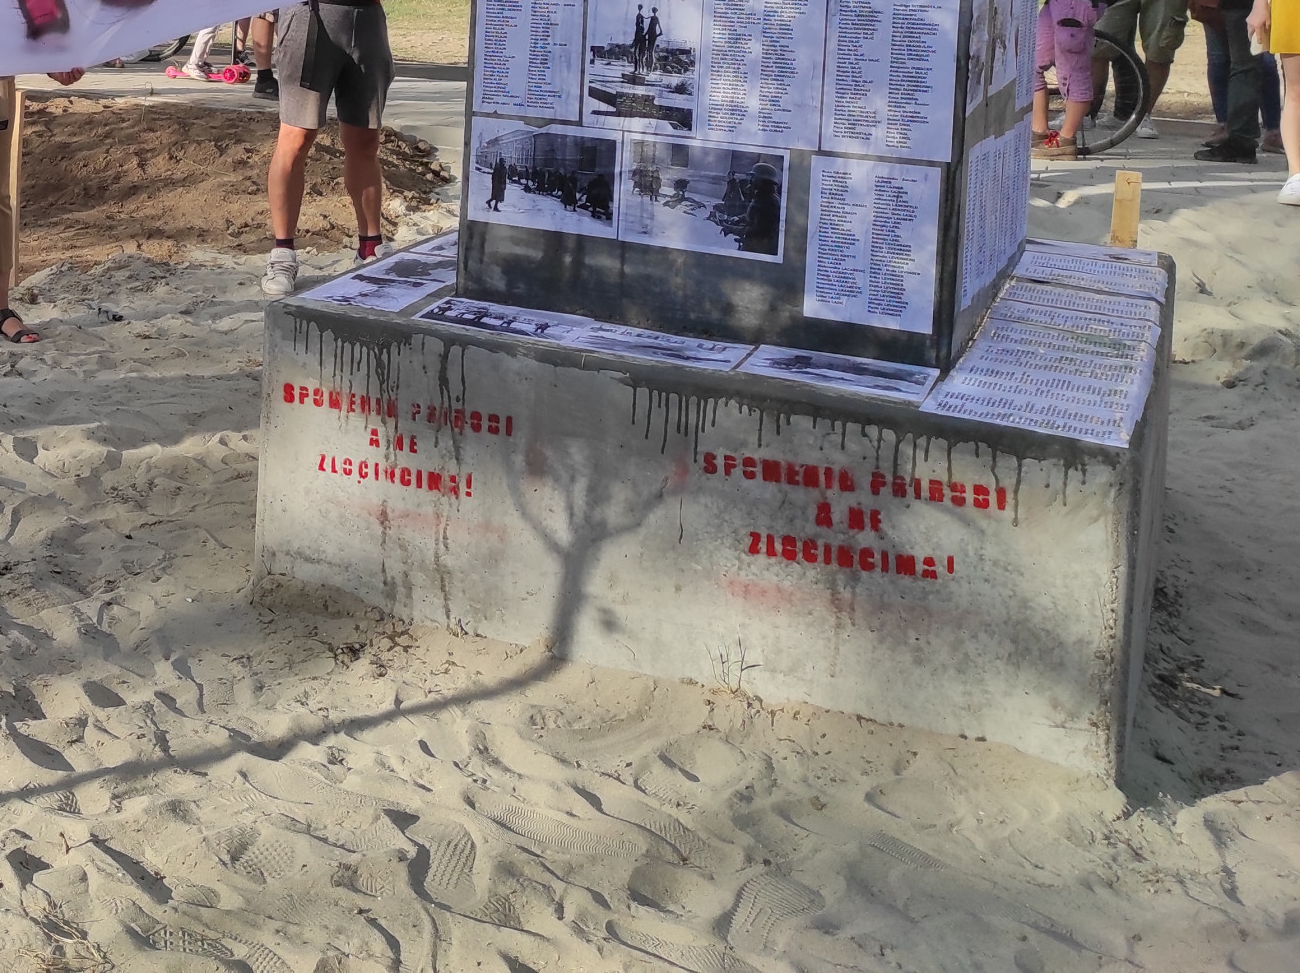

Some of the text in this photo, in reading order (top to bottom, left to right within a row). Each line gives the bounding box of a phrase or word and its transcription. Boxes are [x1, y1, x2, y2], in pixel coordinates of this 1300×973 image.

[369, 428, 418, 454] A NE
[815, 502, 833, 528] A
